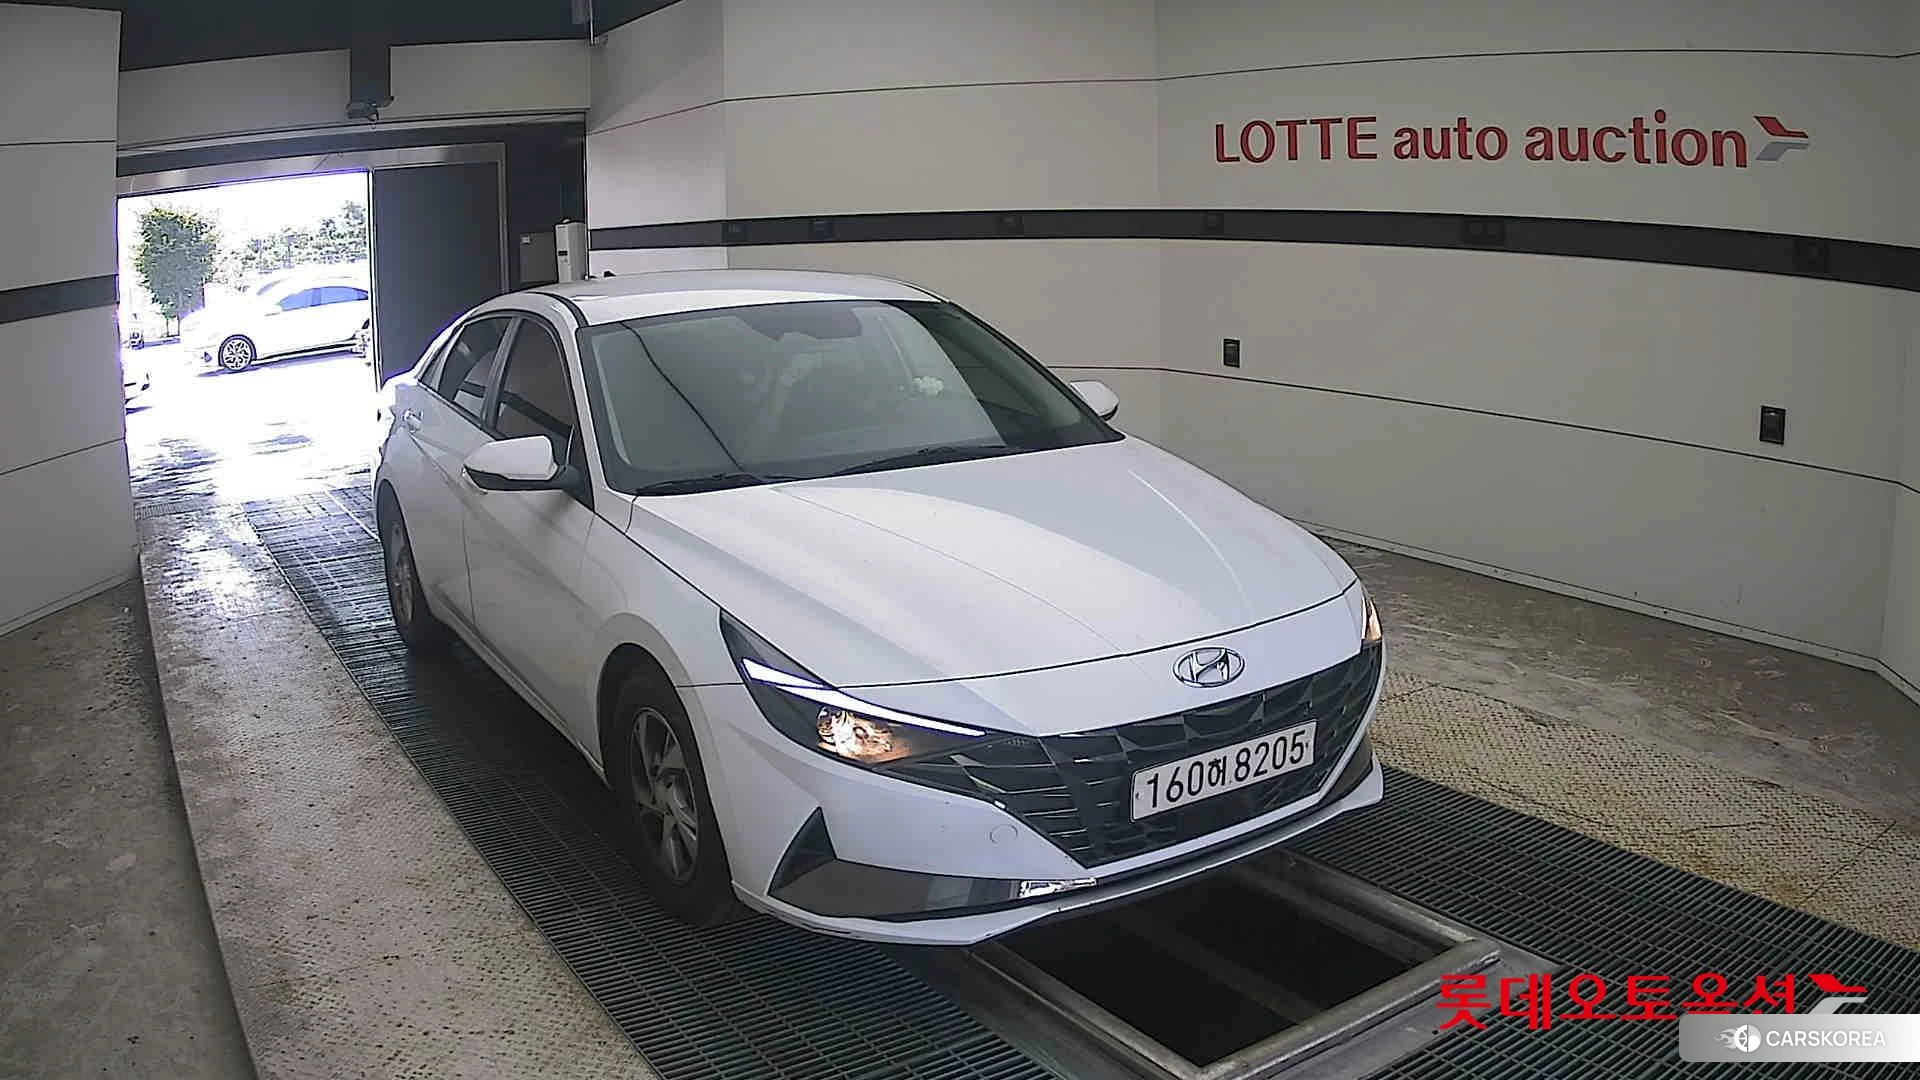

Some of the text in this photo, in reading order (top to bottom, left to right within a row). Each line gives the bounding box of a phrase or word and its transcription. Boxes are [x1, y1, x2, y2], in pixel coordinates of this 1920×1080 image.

[1215, 111, 1748, 167] LOTTE auto auction
